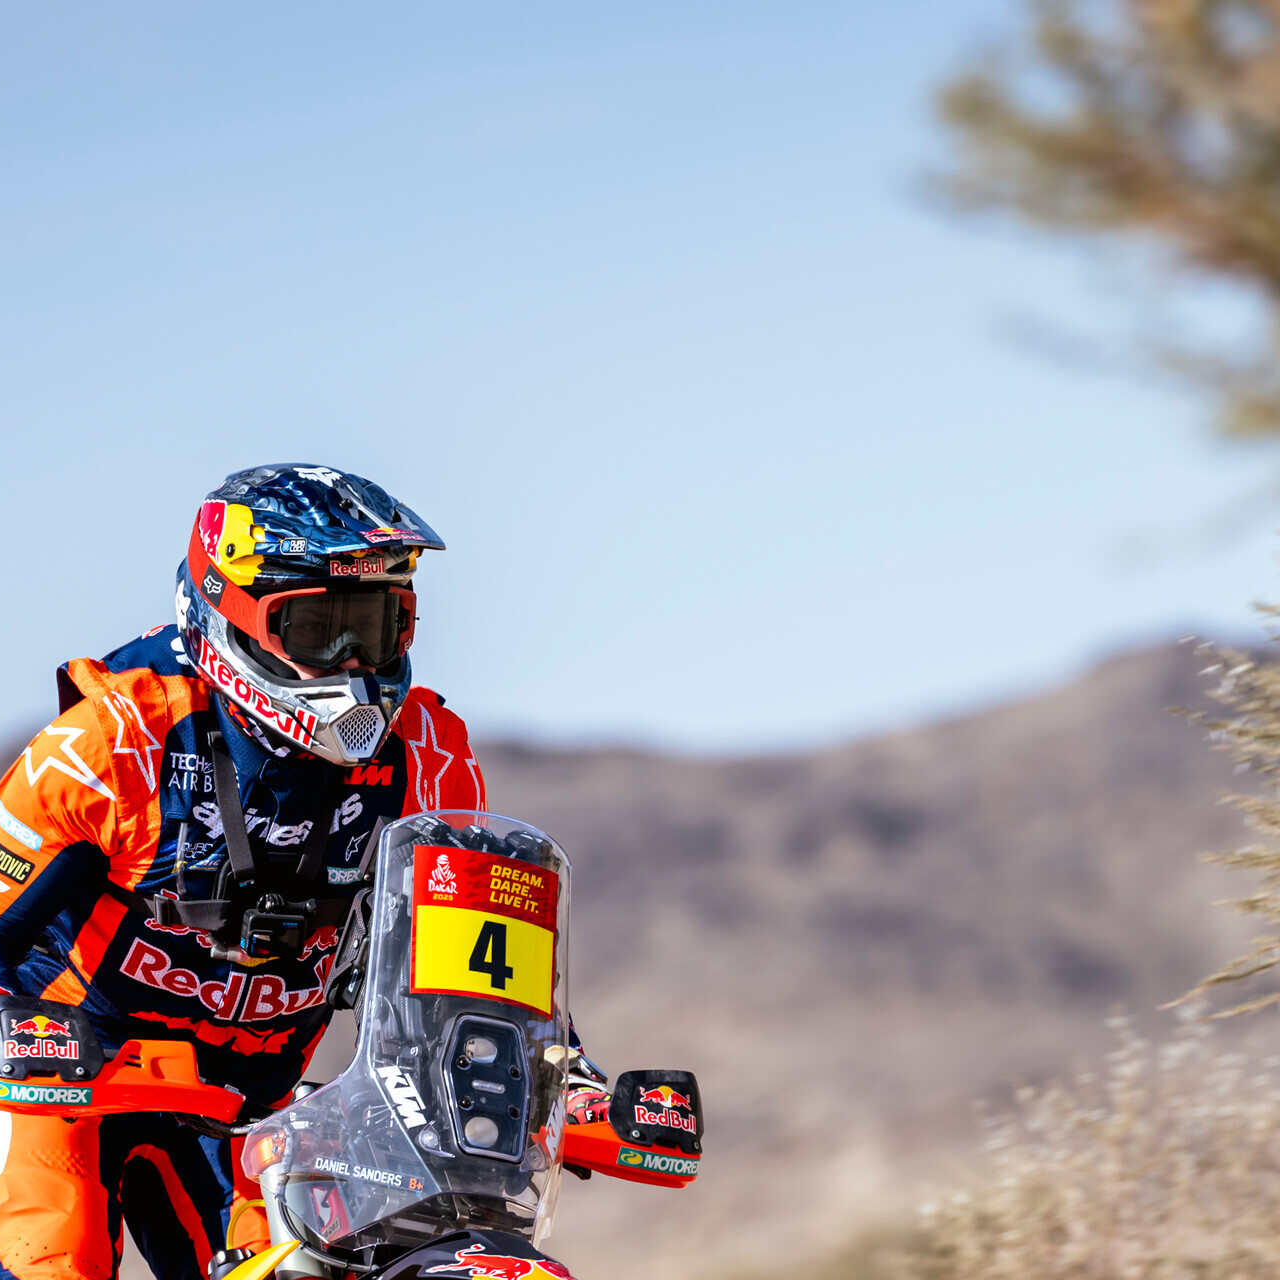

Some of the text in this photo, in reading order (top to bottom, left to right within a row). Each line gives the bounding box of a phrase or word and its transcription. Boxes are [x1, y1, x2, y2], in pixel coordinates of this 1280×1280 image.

[330, 557, 385, 576] Red Bull
[170, 752, 205, 771] TECH
[329, 868, 361, 883] OREX
[489, 864, 545, 889] DREAM.
[427, 879, 459, 895] DAKAR
[432, 893, 454, 901] 2025
[489, 878, 533, 899] DARE.
[488, 891, 540, 914] LIVE IT.
[468, 920, 513, 990] 4
[119, 936, 247, 1022] Red
[4, 1039, 79, 1060] Red Bull
[10, 1084, 87, 1104] MOTOREX
[377, 1065, 428, 1129] KTM
[634, 1105, 697, 1135] Red Bull
[314, 1157, 423, 1191] DANIEL SANDERS B+
[643, 1154, 700, 1174] MOTORE
